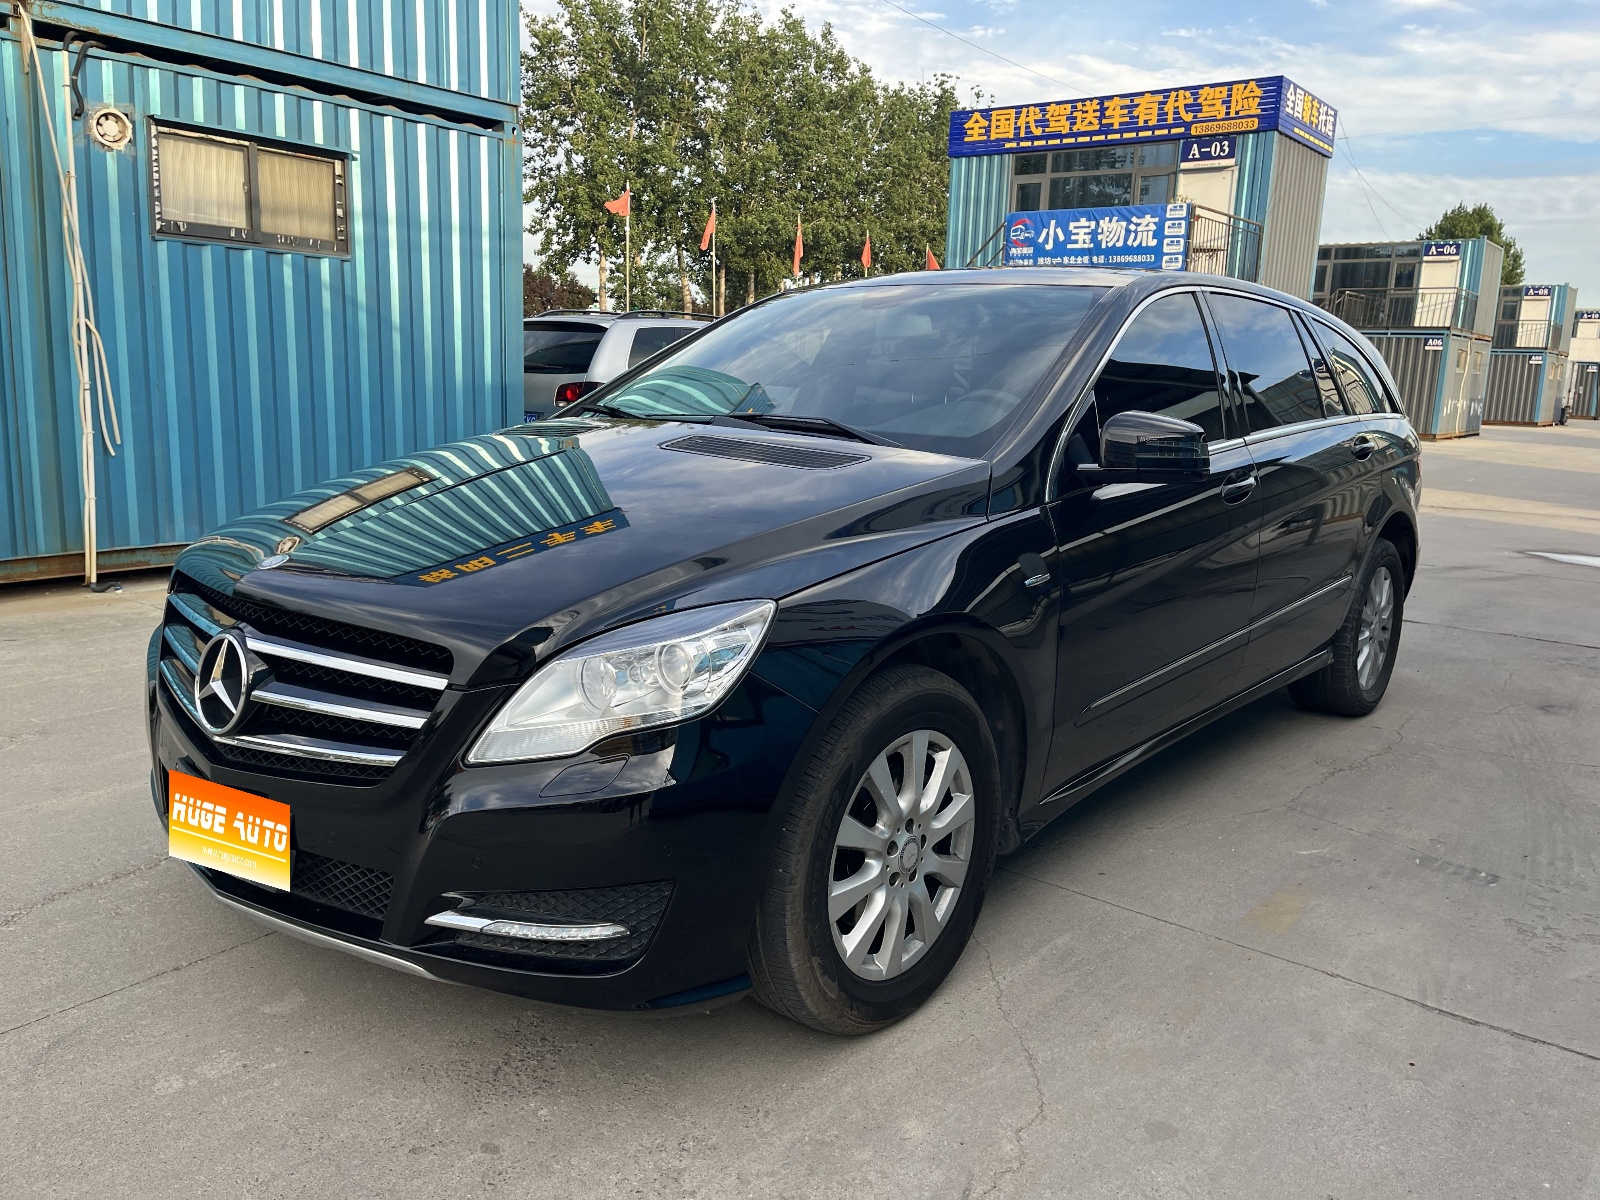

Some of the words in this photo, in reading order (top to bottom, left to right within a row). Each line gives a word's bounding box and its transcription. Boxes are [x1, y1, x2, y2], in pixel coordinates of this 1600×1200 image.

[963, 81, 1263, 142] 全国代驾送车有代驾险
[1194, 120, 1255, 133] 13869688033
[1188, 141, 1229, 158] A-03
[1038, 214, 1159, 250] 小宝物流
[1429, 245, 1456, 255] A-06
[1427, 338, 1442, 346] A06
